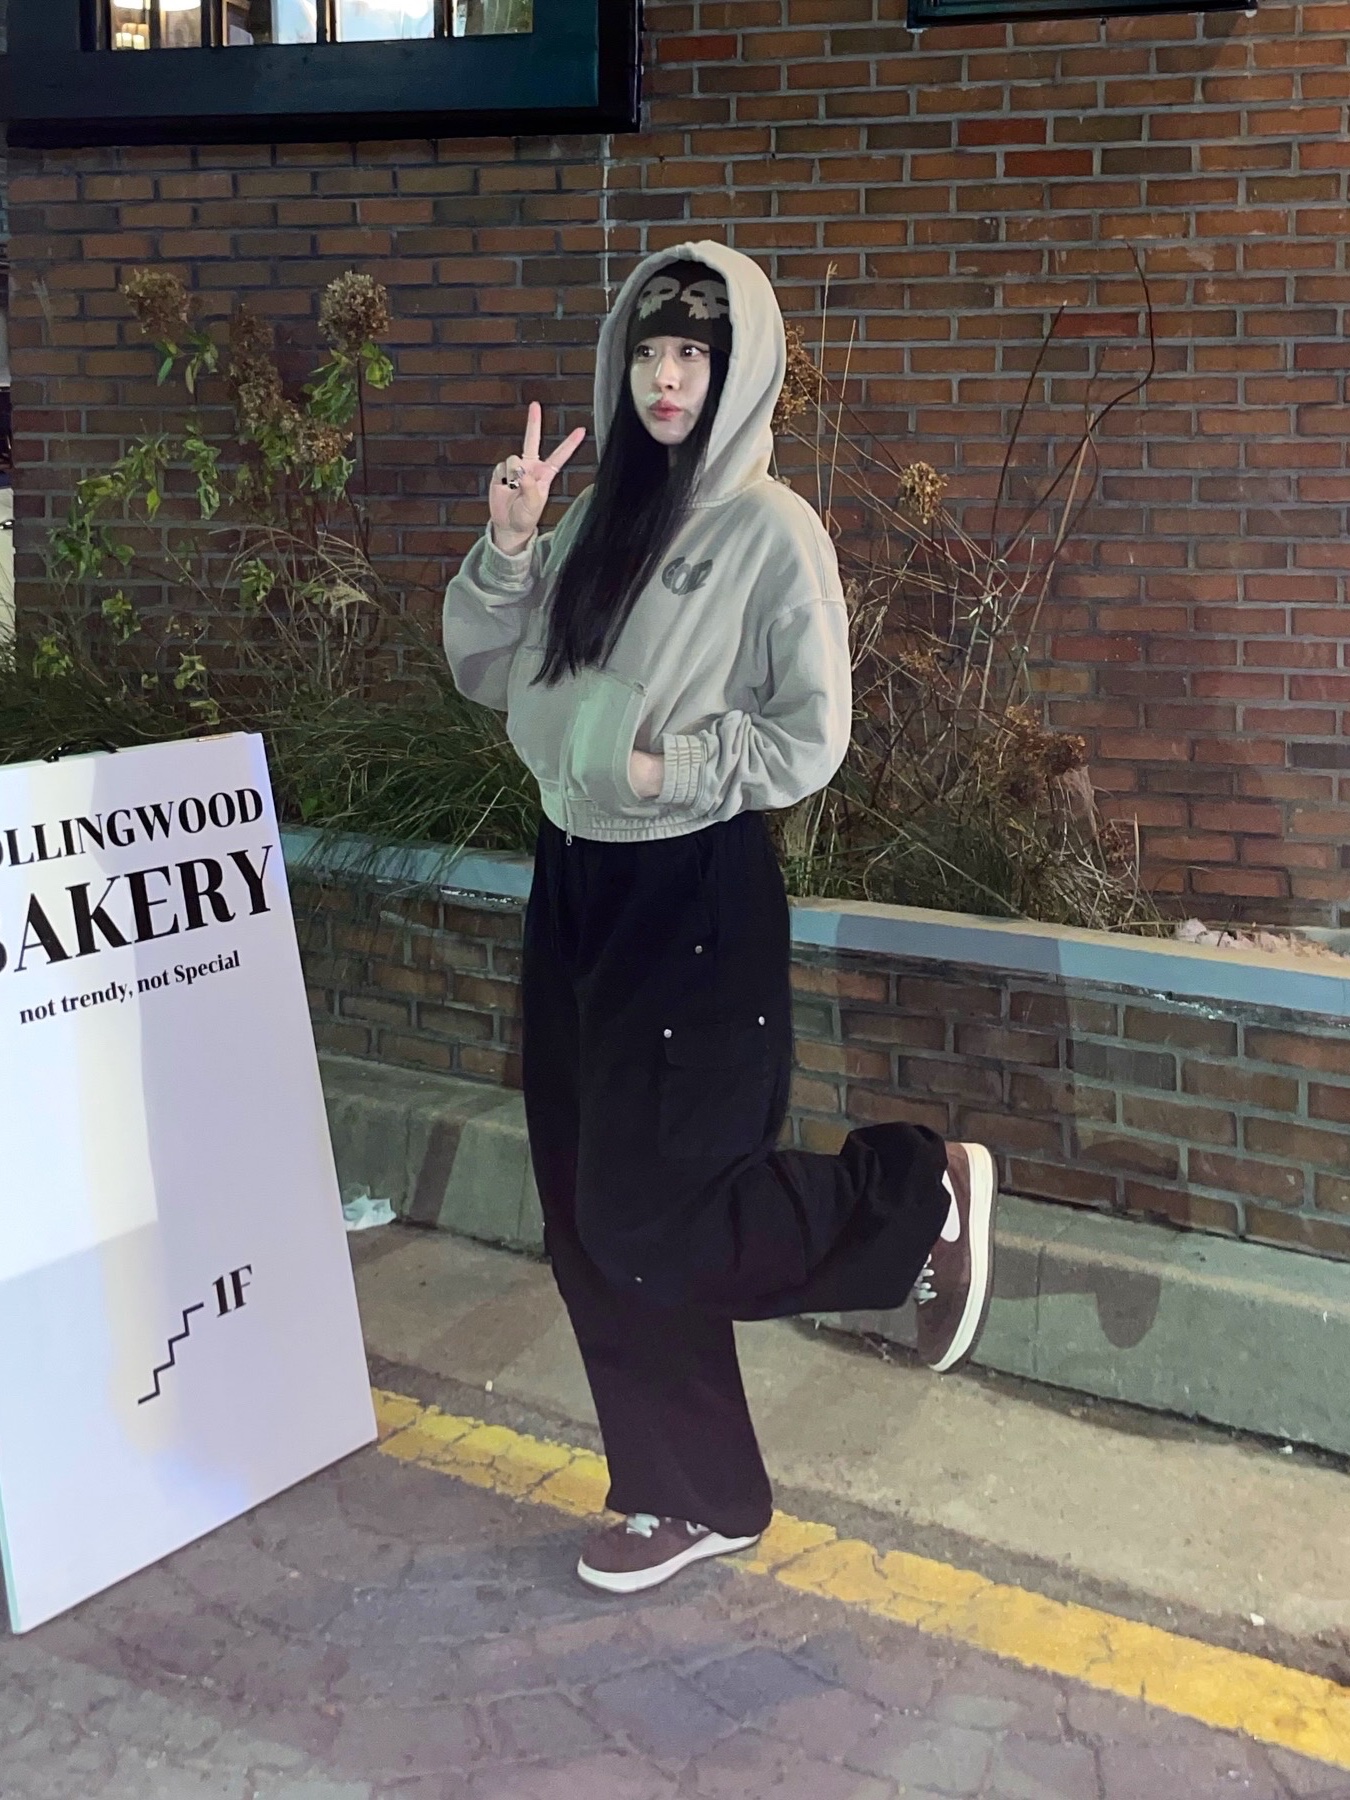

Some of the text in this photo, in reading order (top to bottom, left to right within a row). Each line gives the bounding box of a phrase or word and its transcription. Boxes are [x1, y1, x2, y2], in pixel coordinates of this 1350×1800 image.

[0, 787, 264, 867] LLINGWOOD
[0, 845, 274, 974] AKERY
[19, 950, 241, 1024] not trendy, not Special
[212, 1264, 252, 1318] 1F
